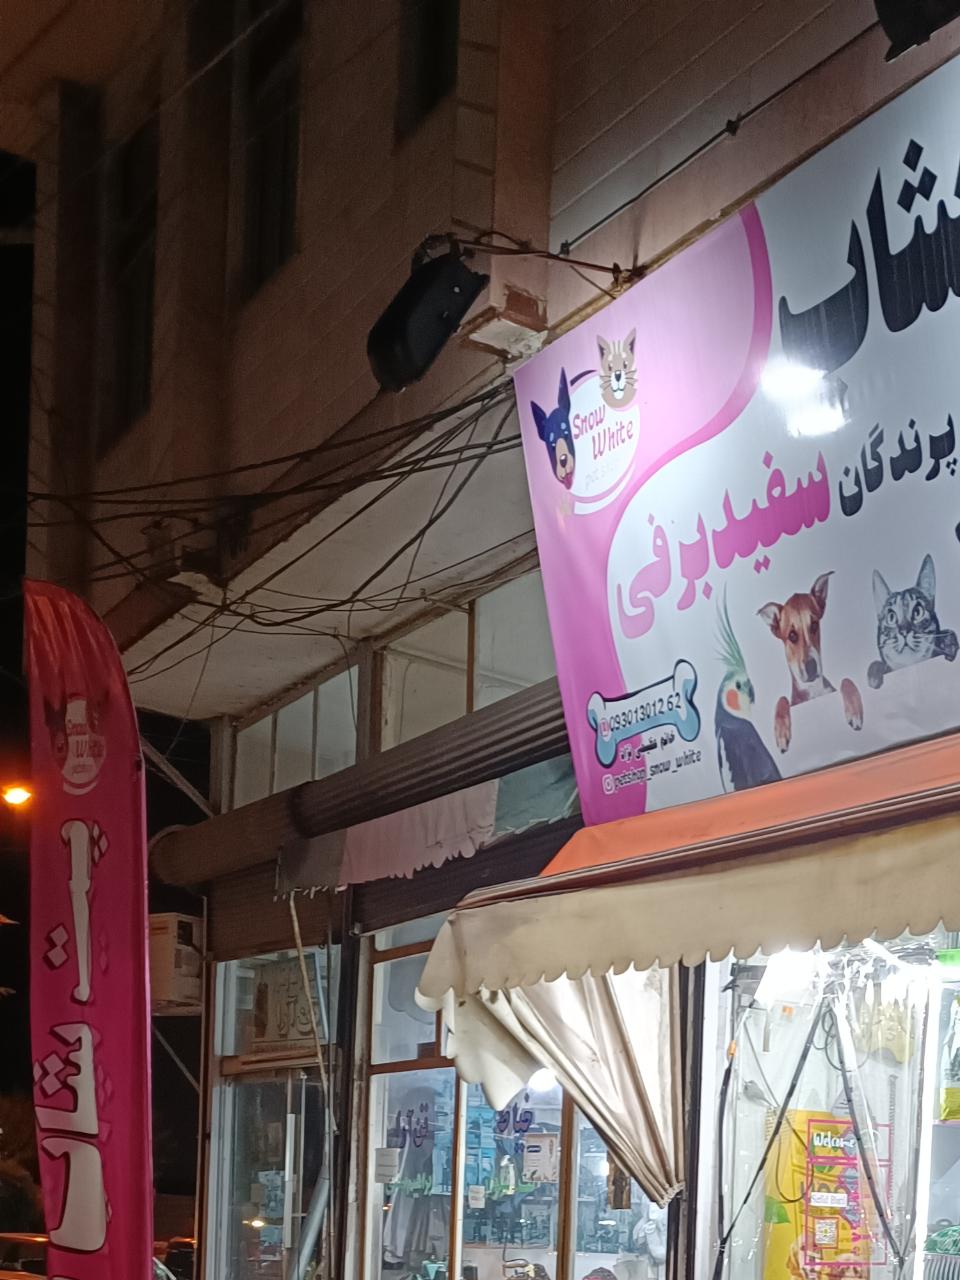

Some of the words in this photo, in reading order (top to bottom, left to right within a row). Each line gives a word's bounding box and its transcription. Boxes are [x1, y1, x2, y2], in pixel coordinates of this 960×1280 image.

[572, 403, 606, 440] Snow
[591, 419, 634, 460] White
[838, 412, 958, 517] پرندگان
[609, 692, 682, 732] 09301301262
[812, 1131, 857, 1149] Welcome
